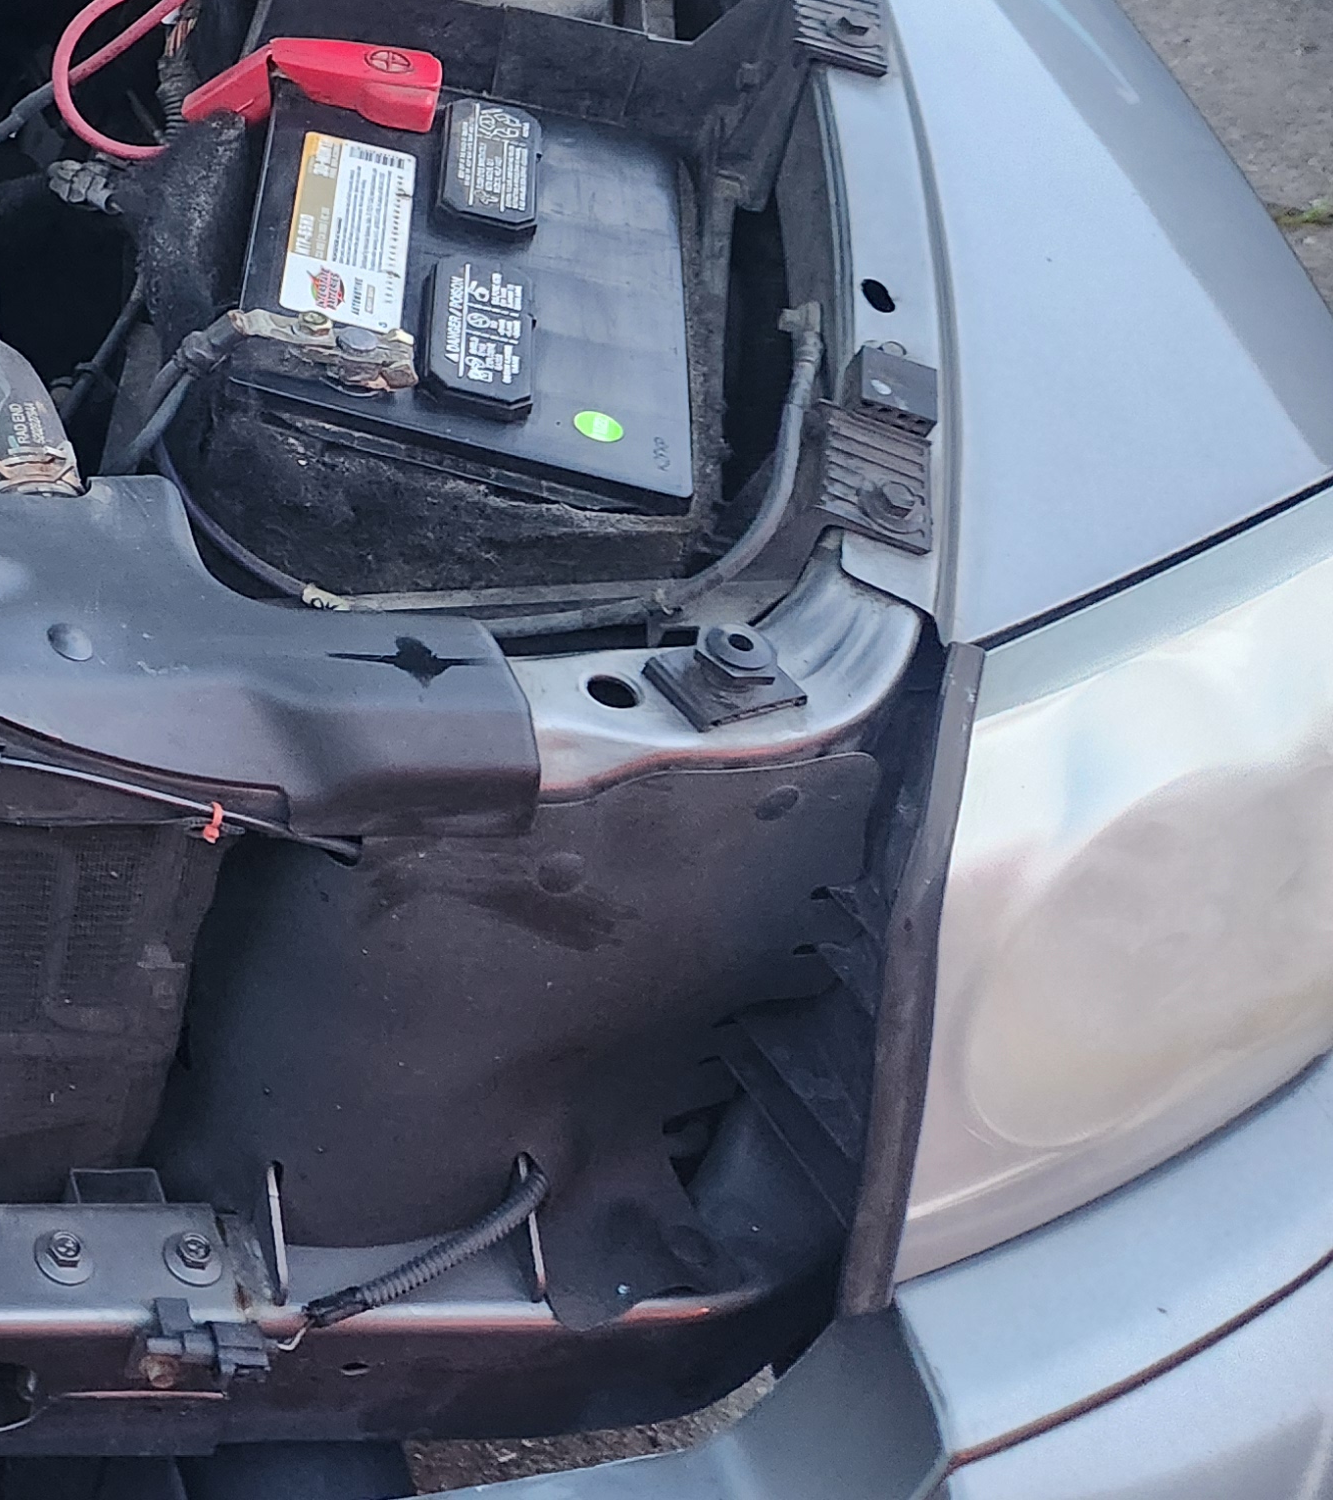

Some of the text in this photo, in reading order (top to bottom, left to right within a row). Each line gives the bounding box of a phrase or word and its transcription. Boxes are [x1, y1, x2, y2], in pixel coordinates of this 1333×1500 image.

[316, 267, 329, 309] INTERSTATE
[326, 272, 339, 310] BATTERIES
[9, 404, 30, 444] RAD END
